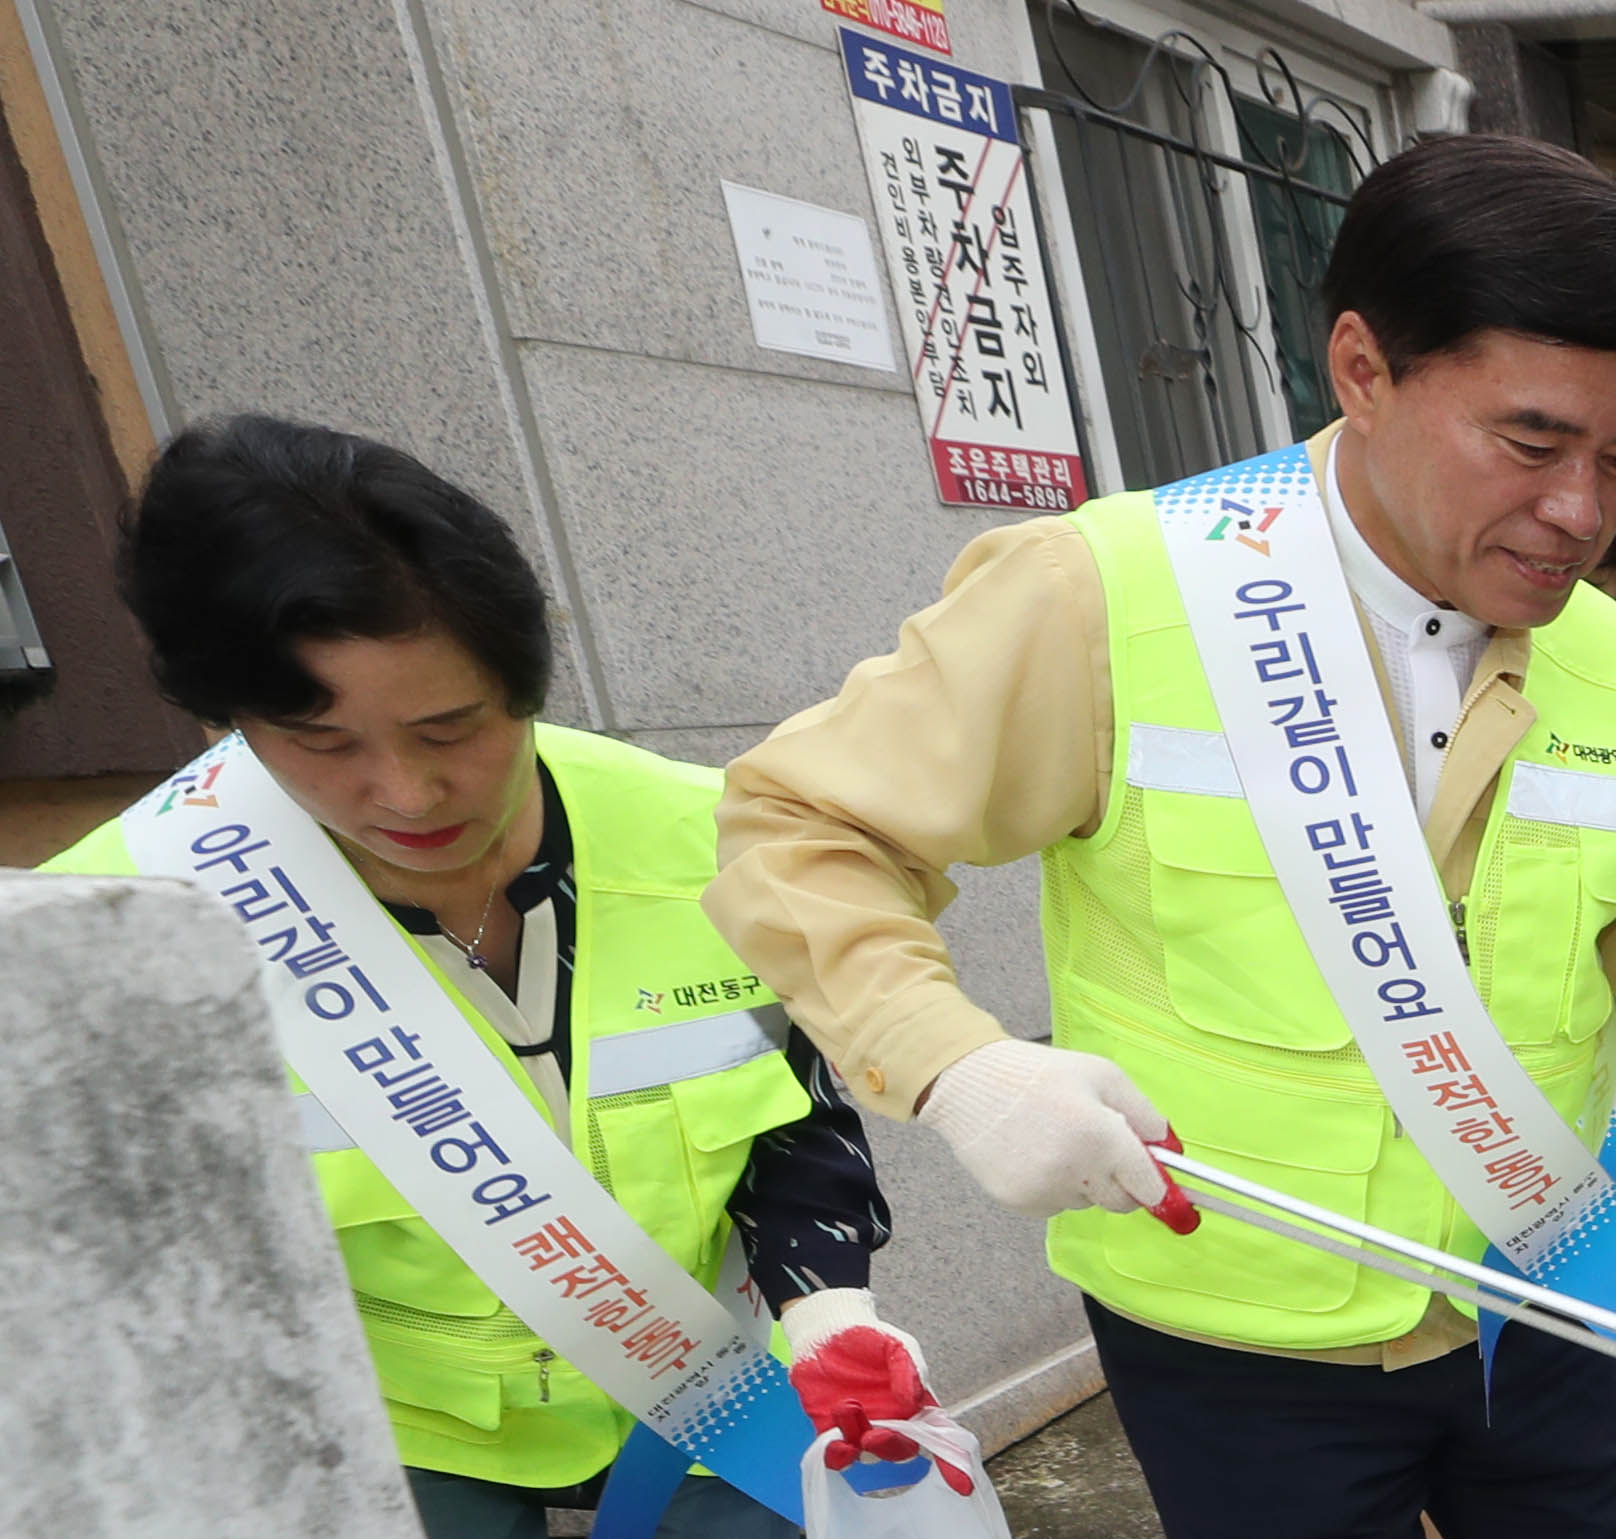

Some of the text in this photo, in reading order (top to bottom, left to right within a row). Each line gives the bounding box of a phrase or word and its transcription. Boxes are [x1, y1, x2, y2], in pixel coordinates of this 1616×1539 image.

[862, 47, 999, 134] 주차금지
[934, 145, 1023, 431] 주차금지
[991, 203, 1048, 394] 입주자외
[947, 447, 1073, 487] 조은주택관리
[963, 478, 1068, 510] 1644-5896
[1234, 578, 1562, 1212] 우리같이 만들어요 쾌적한 동구
[191, 822, 702, 1381] 우리같이 만들어요 쾌적한 동구
